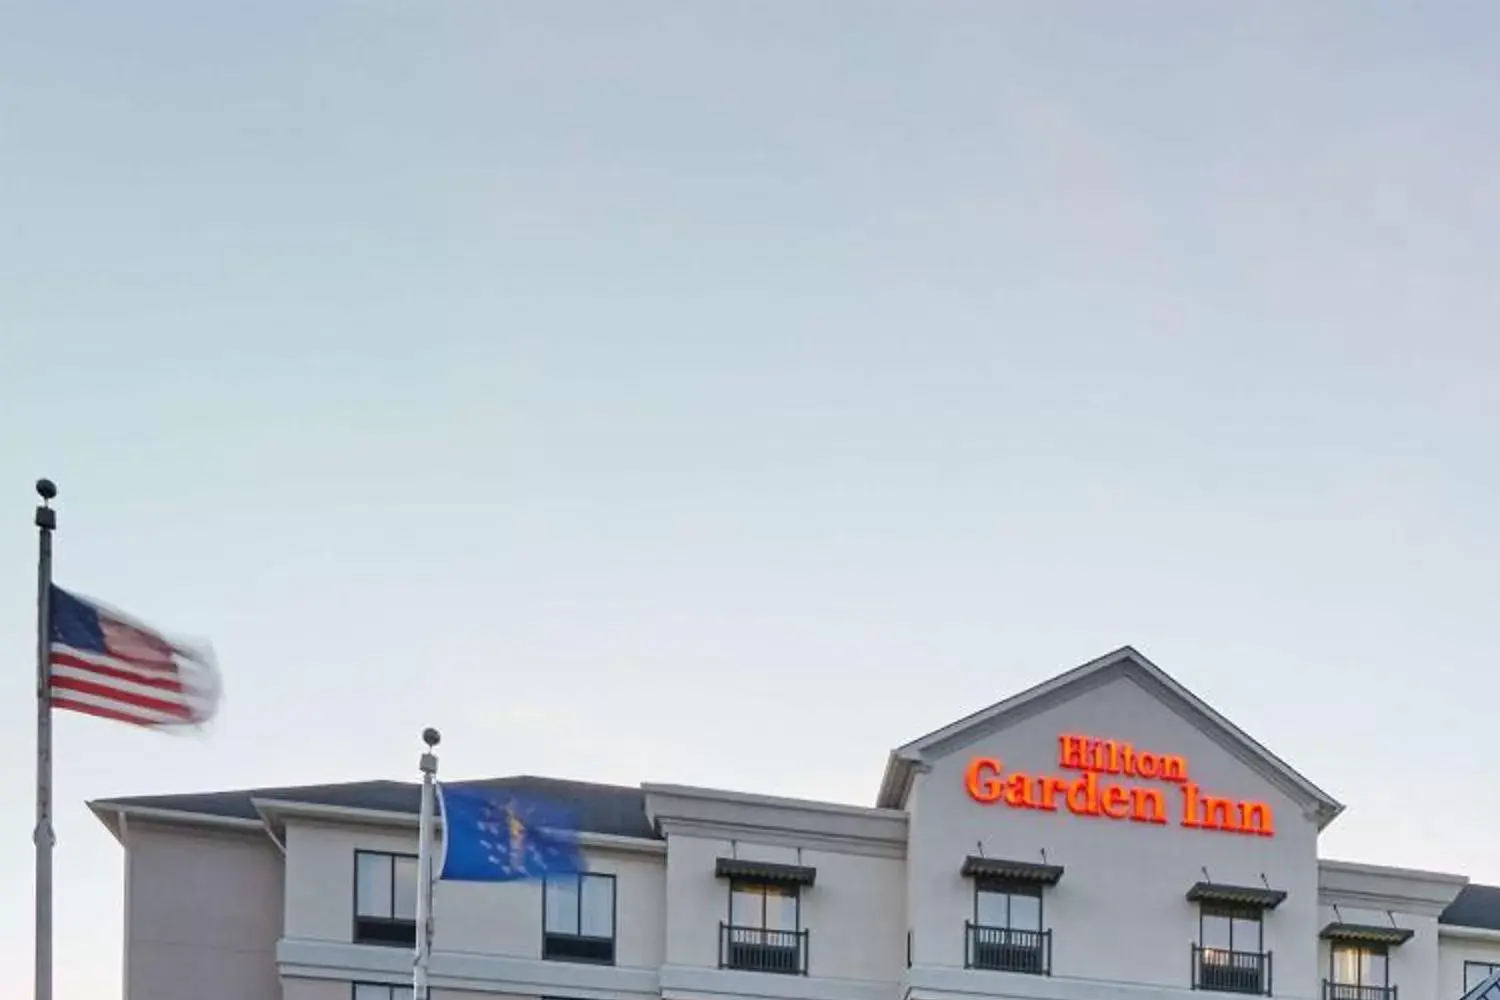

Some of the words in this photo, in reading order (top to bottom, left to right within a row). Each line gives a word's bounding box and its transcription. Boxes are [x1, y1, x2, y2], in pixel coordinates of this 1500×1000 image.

[1059, 735, 1188, 783] Hilton
[966, 757, 1167, 824] Garden
[1180, 783, 1274, 837] Inn
